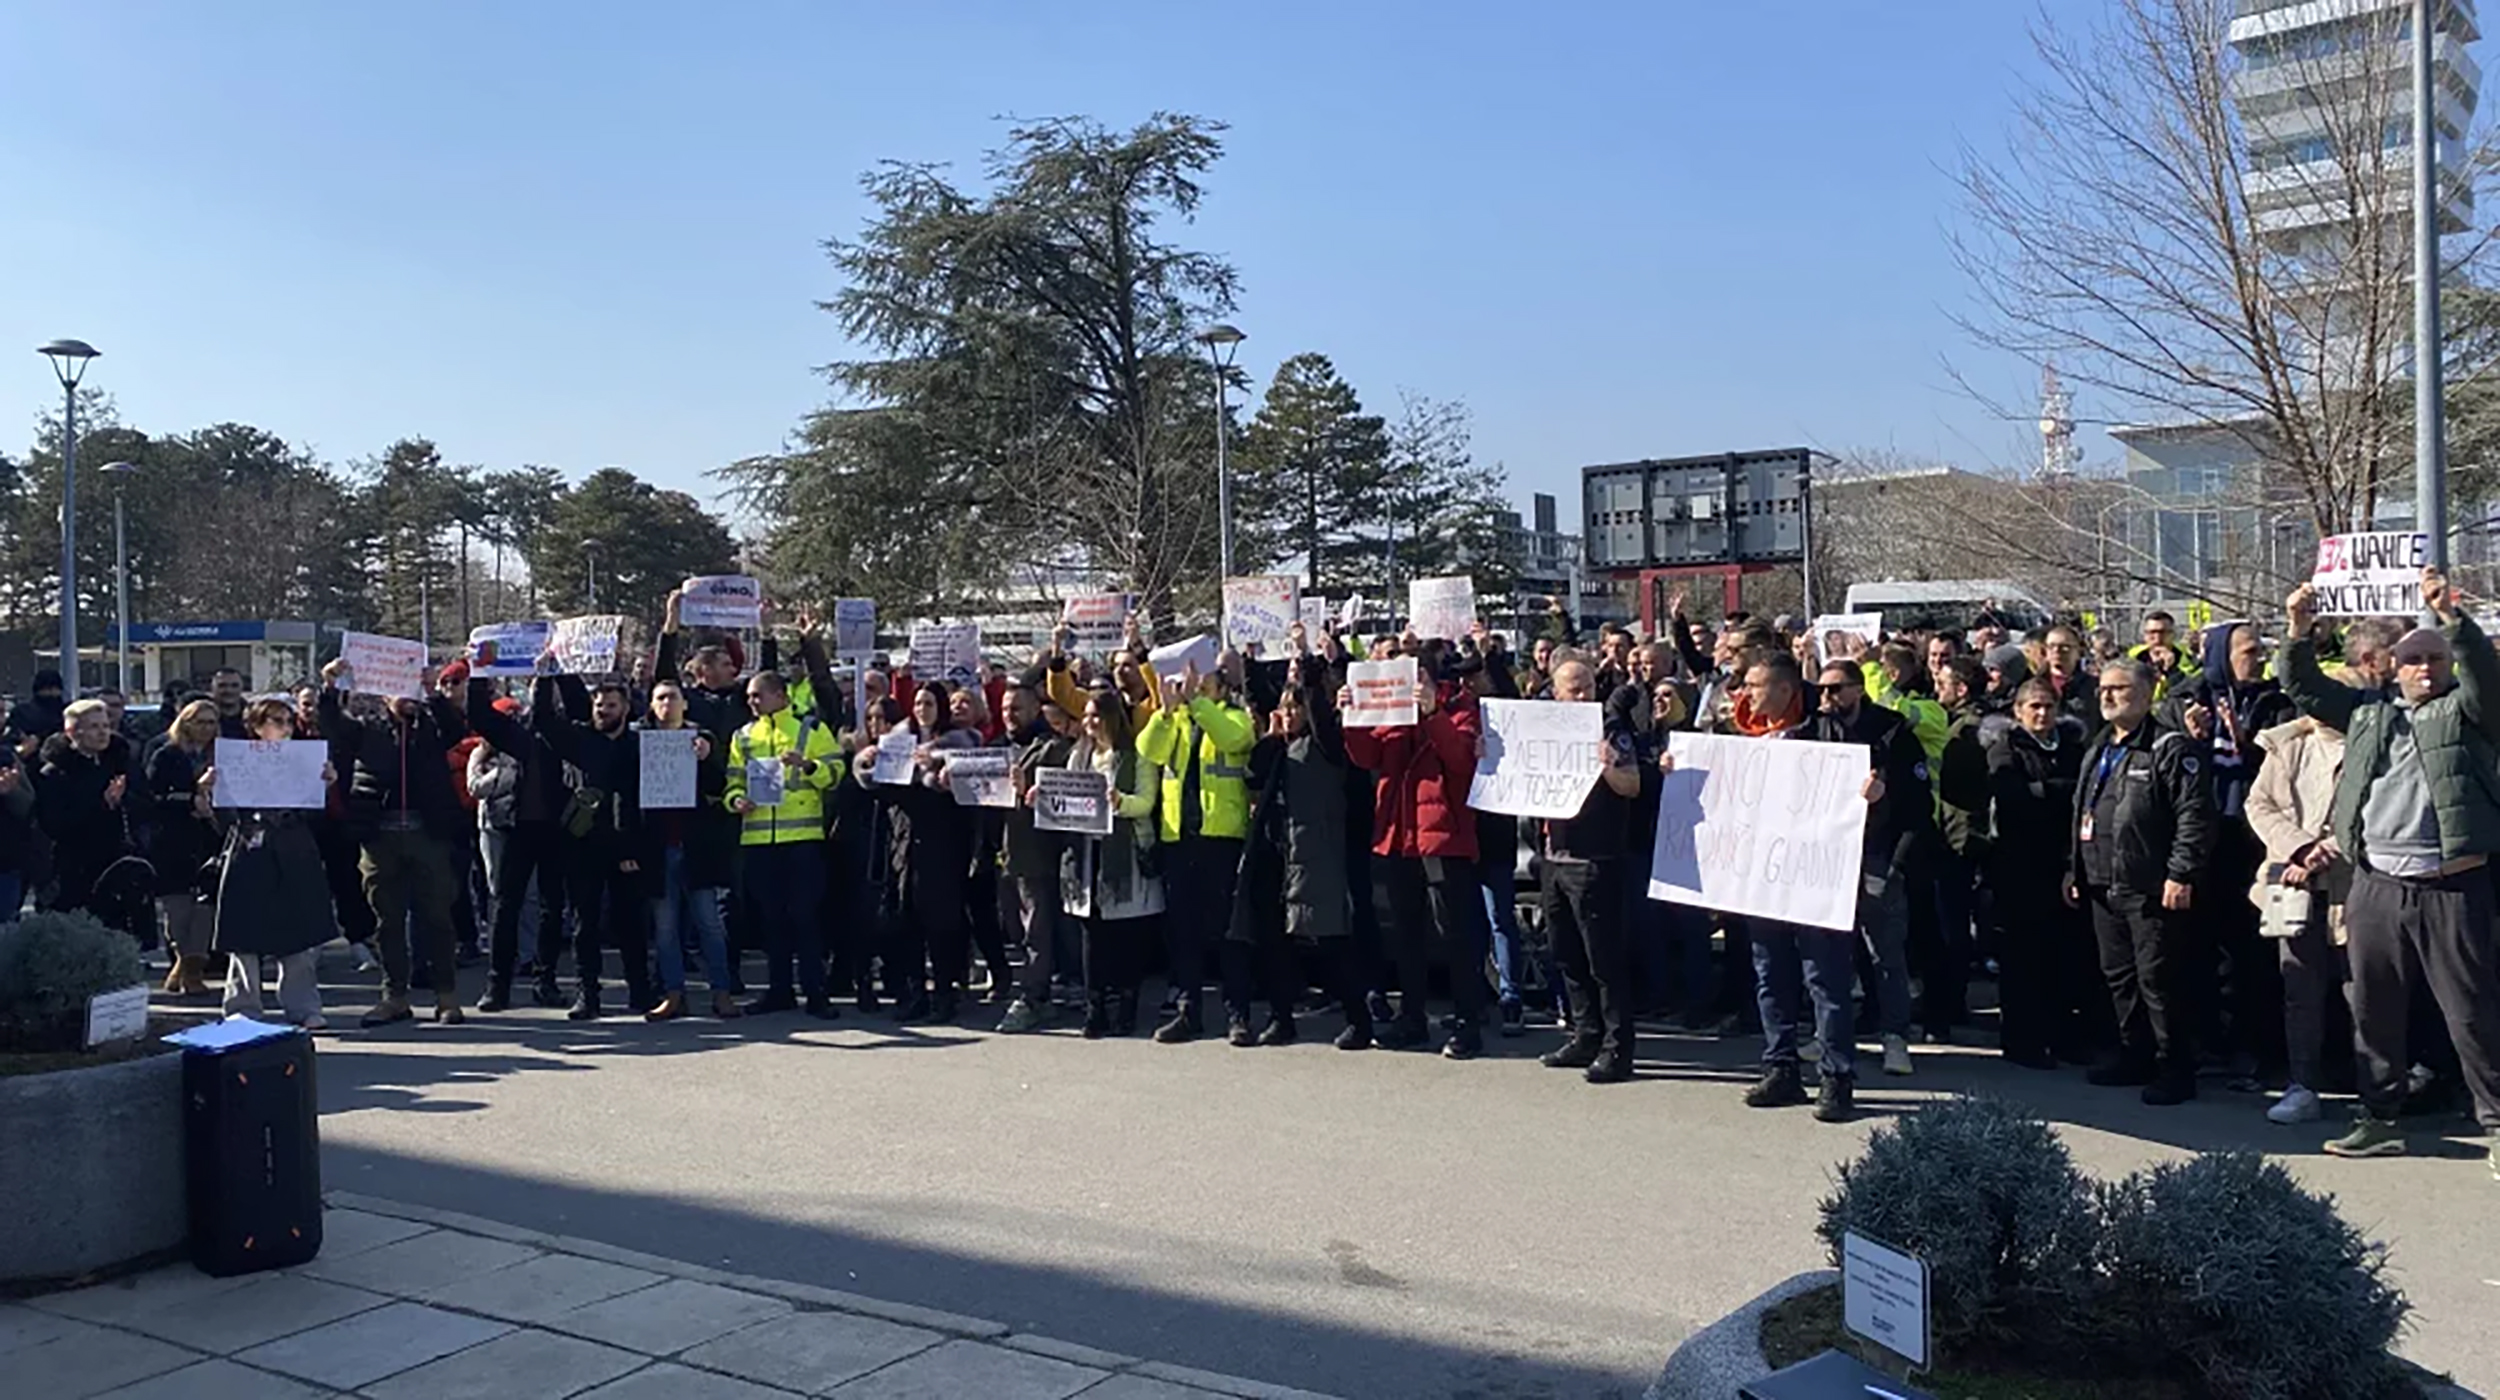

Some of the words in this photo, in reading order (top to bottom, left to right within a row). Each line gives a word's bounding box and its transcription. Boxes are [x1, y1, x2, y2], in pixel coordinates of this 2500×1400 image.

[1512, 738, 1600, 775] ЛЕТИТЕ
[1786, 748, 1852, 817] SIT
[1764, 836, 1846, 891] GLADNI
